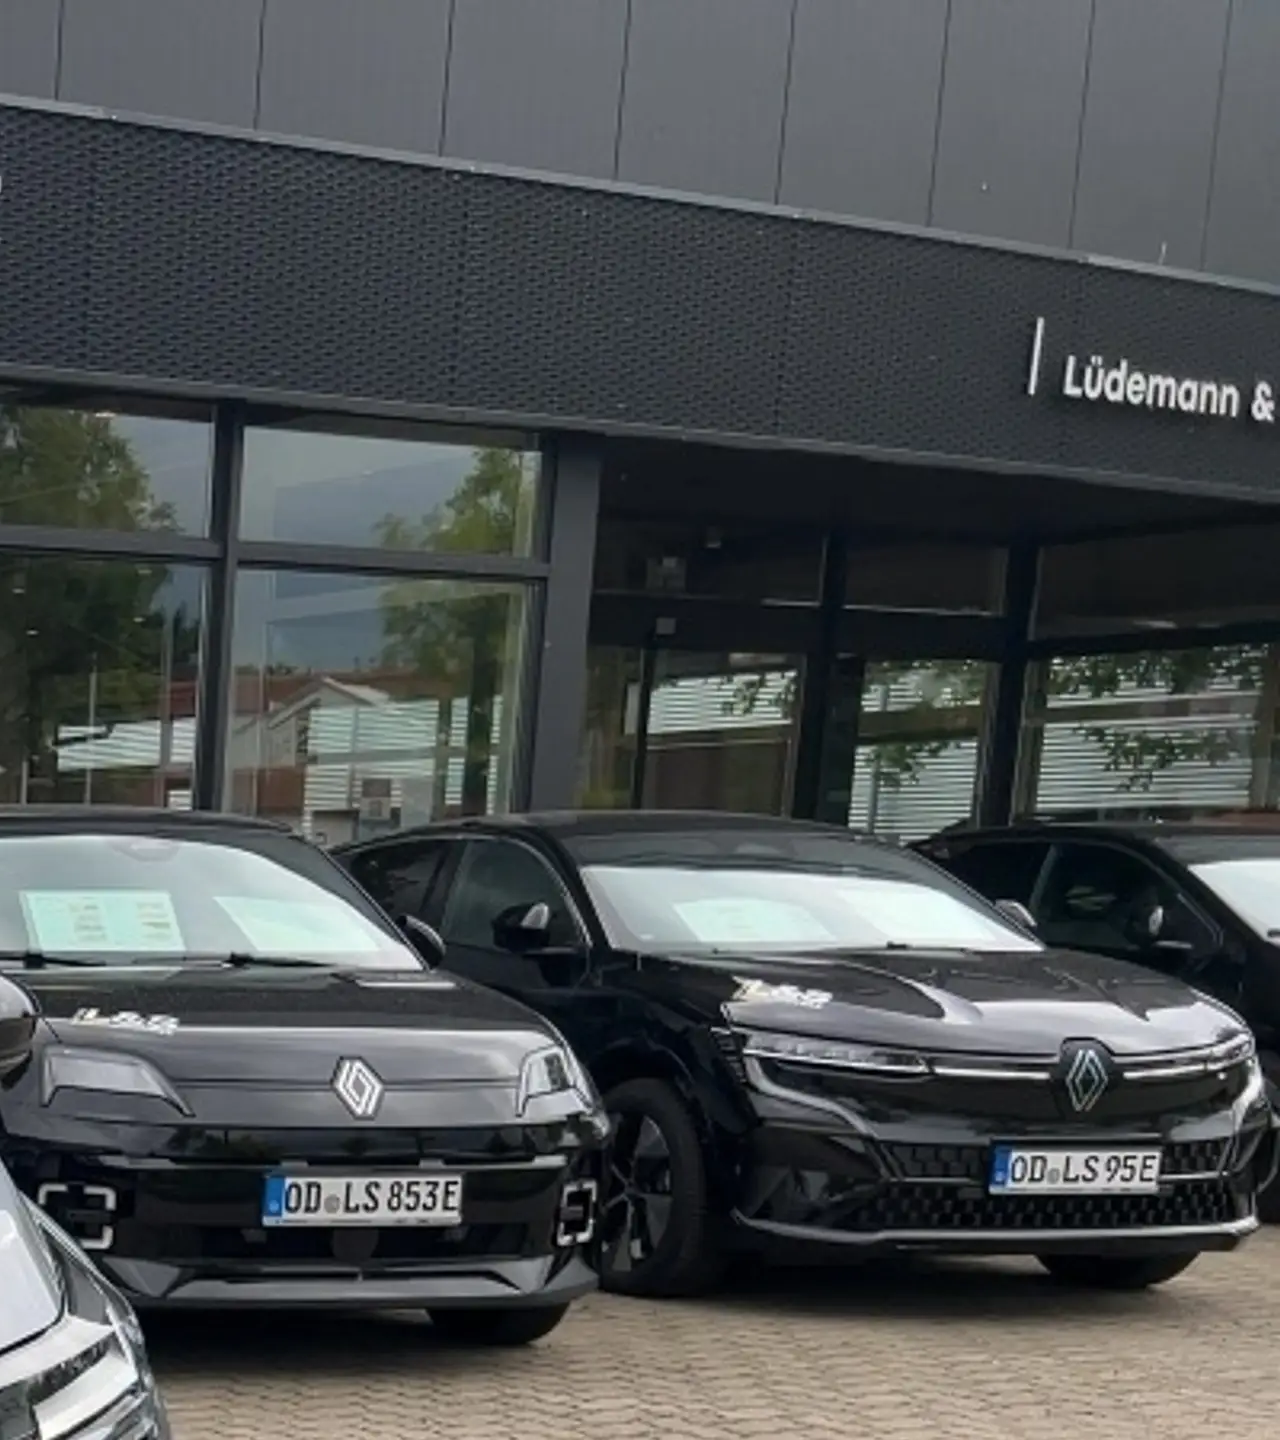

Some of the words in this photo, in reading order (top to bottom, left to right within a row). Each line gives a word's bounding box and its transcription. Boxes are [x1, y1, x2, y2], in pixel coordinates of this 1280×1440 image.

[1062, 354, 1241, 418] Lüdemann
[1250, 380, 1276, 423] &
[1010, 1154, 1049, 1184] OD
[1061, 1154, 1101, 1184] LS
[1105, 1154, 1158, 1184] 95E
[283, 1180, 323, 1215] OD
[342, 1181, 382, 1214] LS
[386, 1180, 461, 1213] 853E
